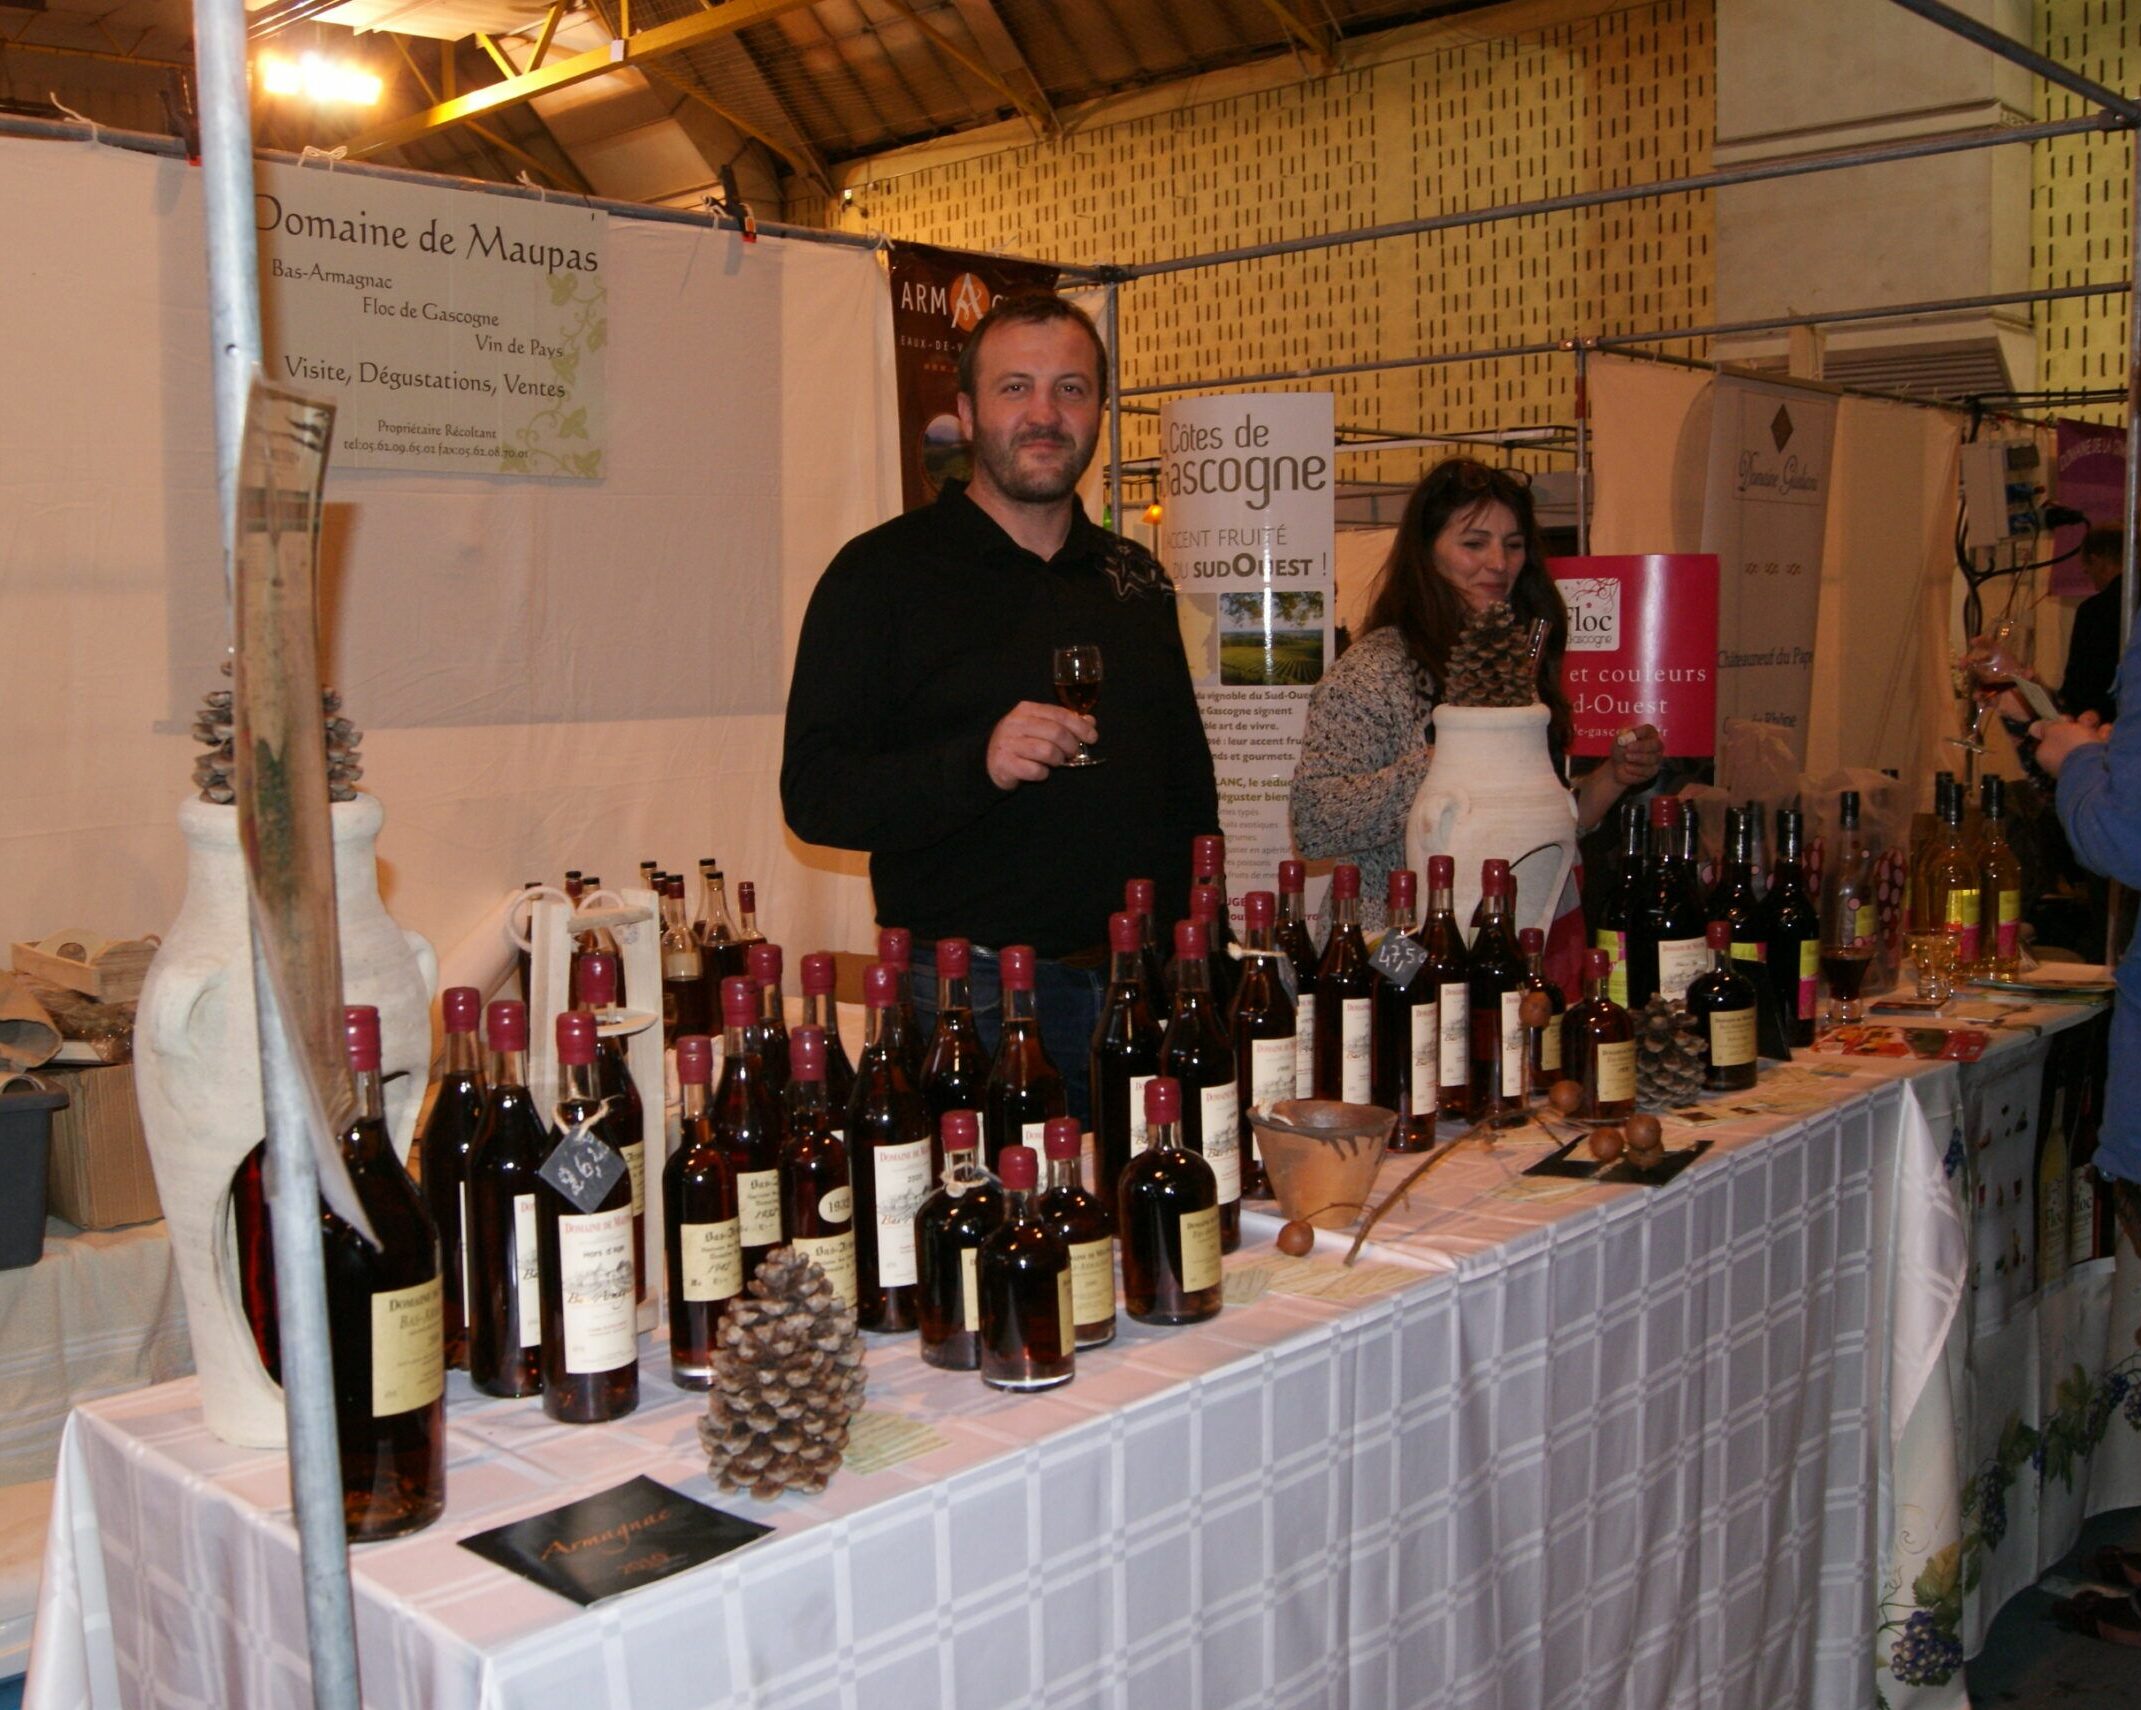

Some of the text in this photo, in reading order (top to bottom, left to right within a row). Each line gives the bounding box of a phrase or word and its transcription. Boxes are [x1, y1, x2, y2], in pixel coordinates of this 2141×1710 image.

[256, 194, 599, 275] Domaine de Maupas
[272, 258, 393, 290] Bas-Armagnac
[363, 296, 500, 328] Floc de Gascogne
[475, 333, 503, 352] Vin
[508, 337, 526, 354] de
[285, 355, 567, 399] Visite, Dégustations, Ventes
[378, 419, 498, 440] Propriétaire Récoltant
[1169, 413, 1270, 454] Côtes de
[1218, 523, 1290, 546] FRUITÉ
[1570, 667, 1707, 683] et couleurs
[1249, 691, 1262, 700] du
[1253, 706, 1293, 718] signent
[1235, 722, 1247, 730] de
[1249, 737, 1283, 746] accent
[540, 1508, 671, 1562] Armagnac
